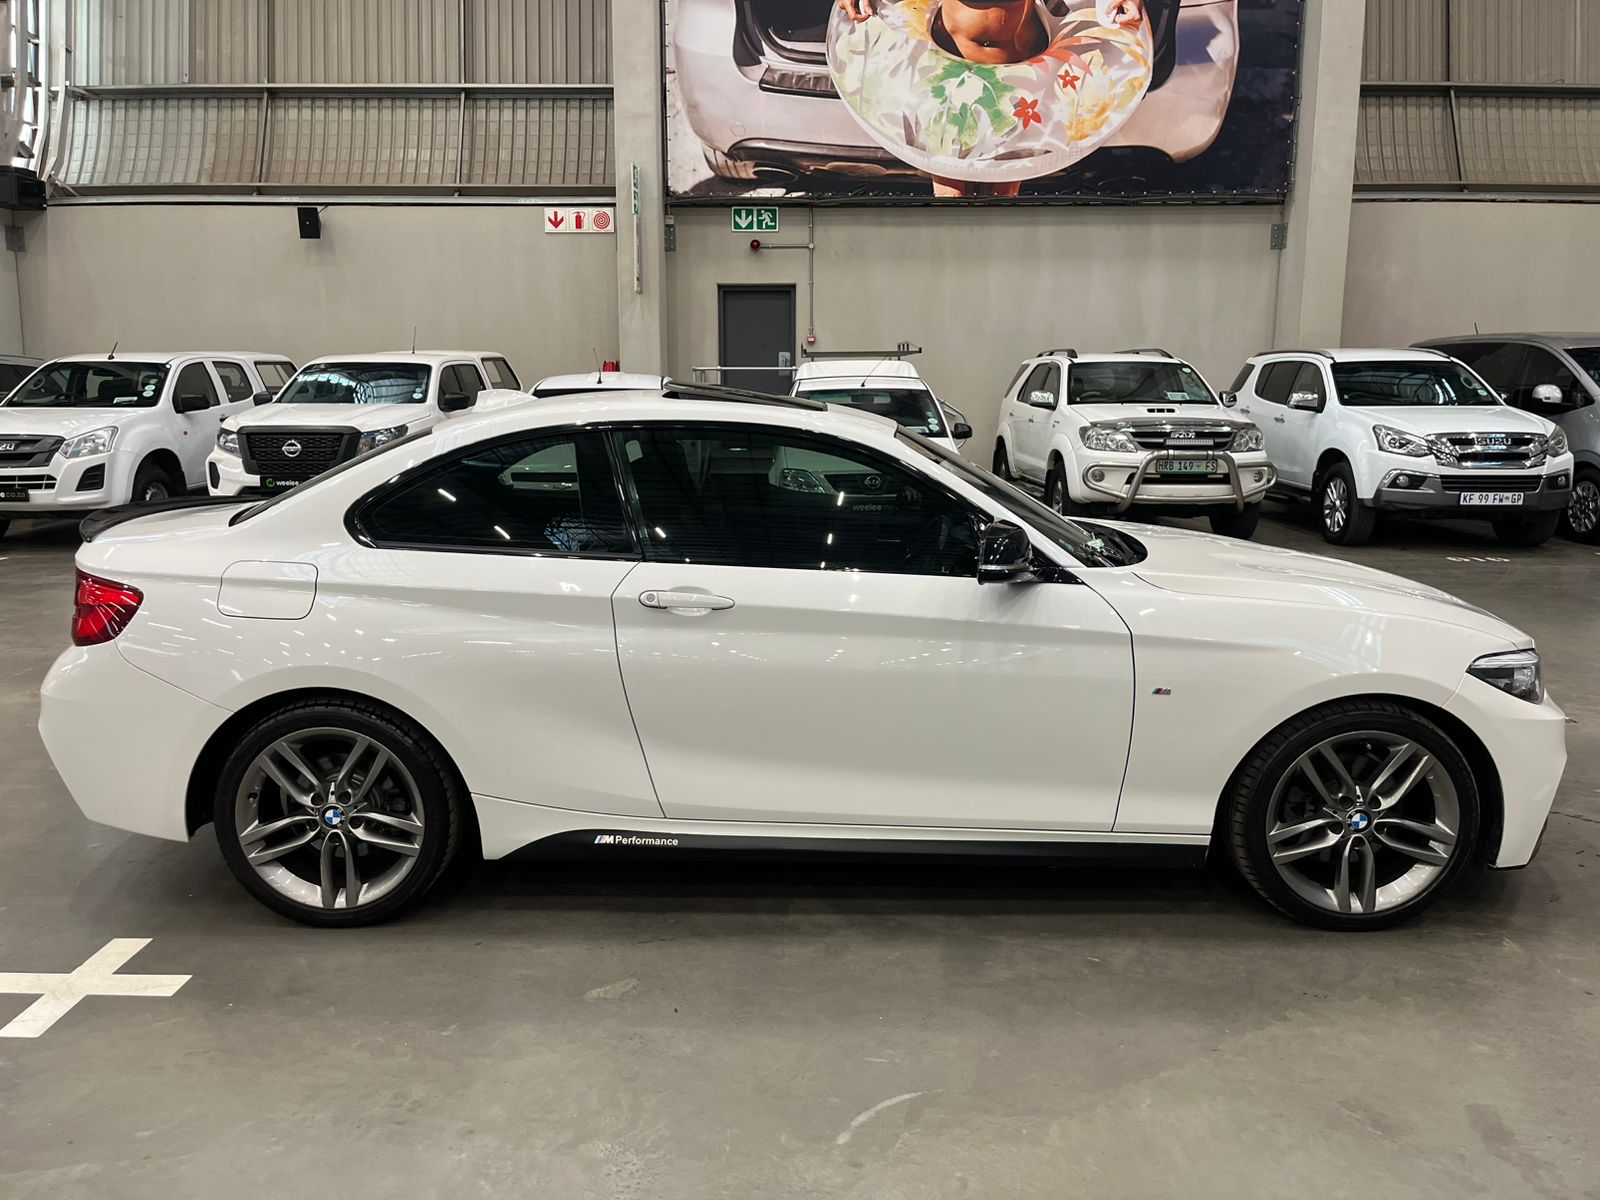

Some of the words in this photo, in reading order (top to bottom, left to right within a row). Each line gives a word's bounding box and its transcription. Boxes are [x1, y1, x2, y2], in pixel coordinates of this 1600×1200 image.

[1474, 437, 1511, 445] ISUZU
[1158, 461, 1174, 471] HRB
[1178, 461, 1194, 471] 149
[1205, 461, 1216, 471] FS
[1462, 493, 1475, 503] KF
[1478, 493, 1490, 503] 99
[1492, 493, 1505, 503] FW
[1510, 493, 1522, 503] GP
[615, 835, 679, 846] Performance
